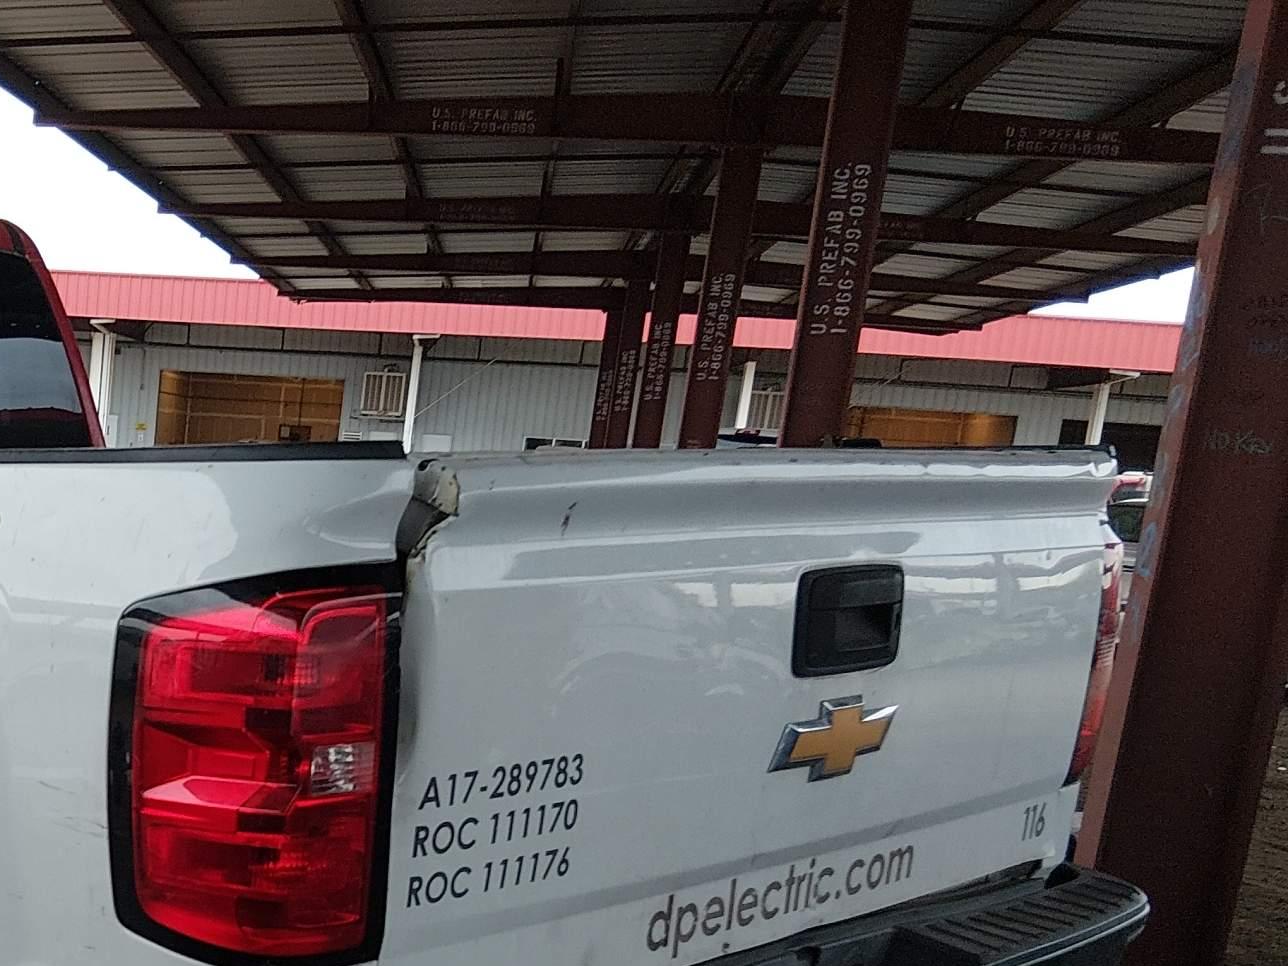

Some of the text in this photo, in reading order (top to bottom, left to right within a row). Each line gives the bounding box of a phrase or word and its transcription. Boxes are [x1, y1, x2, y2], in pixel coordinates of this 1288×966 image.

[810, 162, 853, 335] U.S. PREFAB INC.
[830, 164, 873, 334] 1-866-799-0969
[709, 273, 724, 297] INC.
[700, 302, 719, 351] PREFAB
[417, 753, 584, 810] A17-289783
[412, 799, 579, 858] ROC 111170
[1021, 802, 1047, 841] 116
[406, 847, 571, 908] ROC 111176
[646, 844, 914, 958] dpelectric.com
